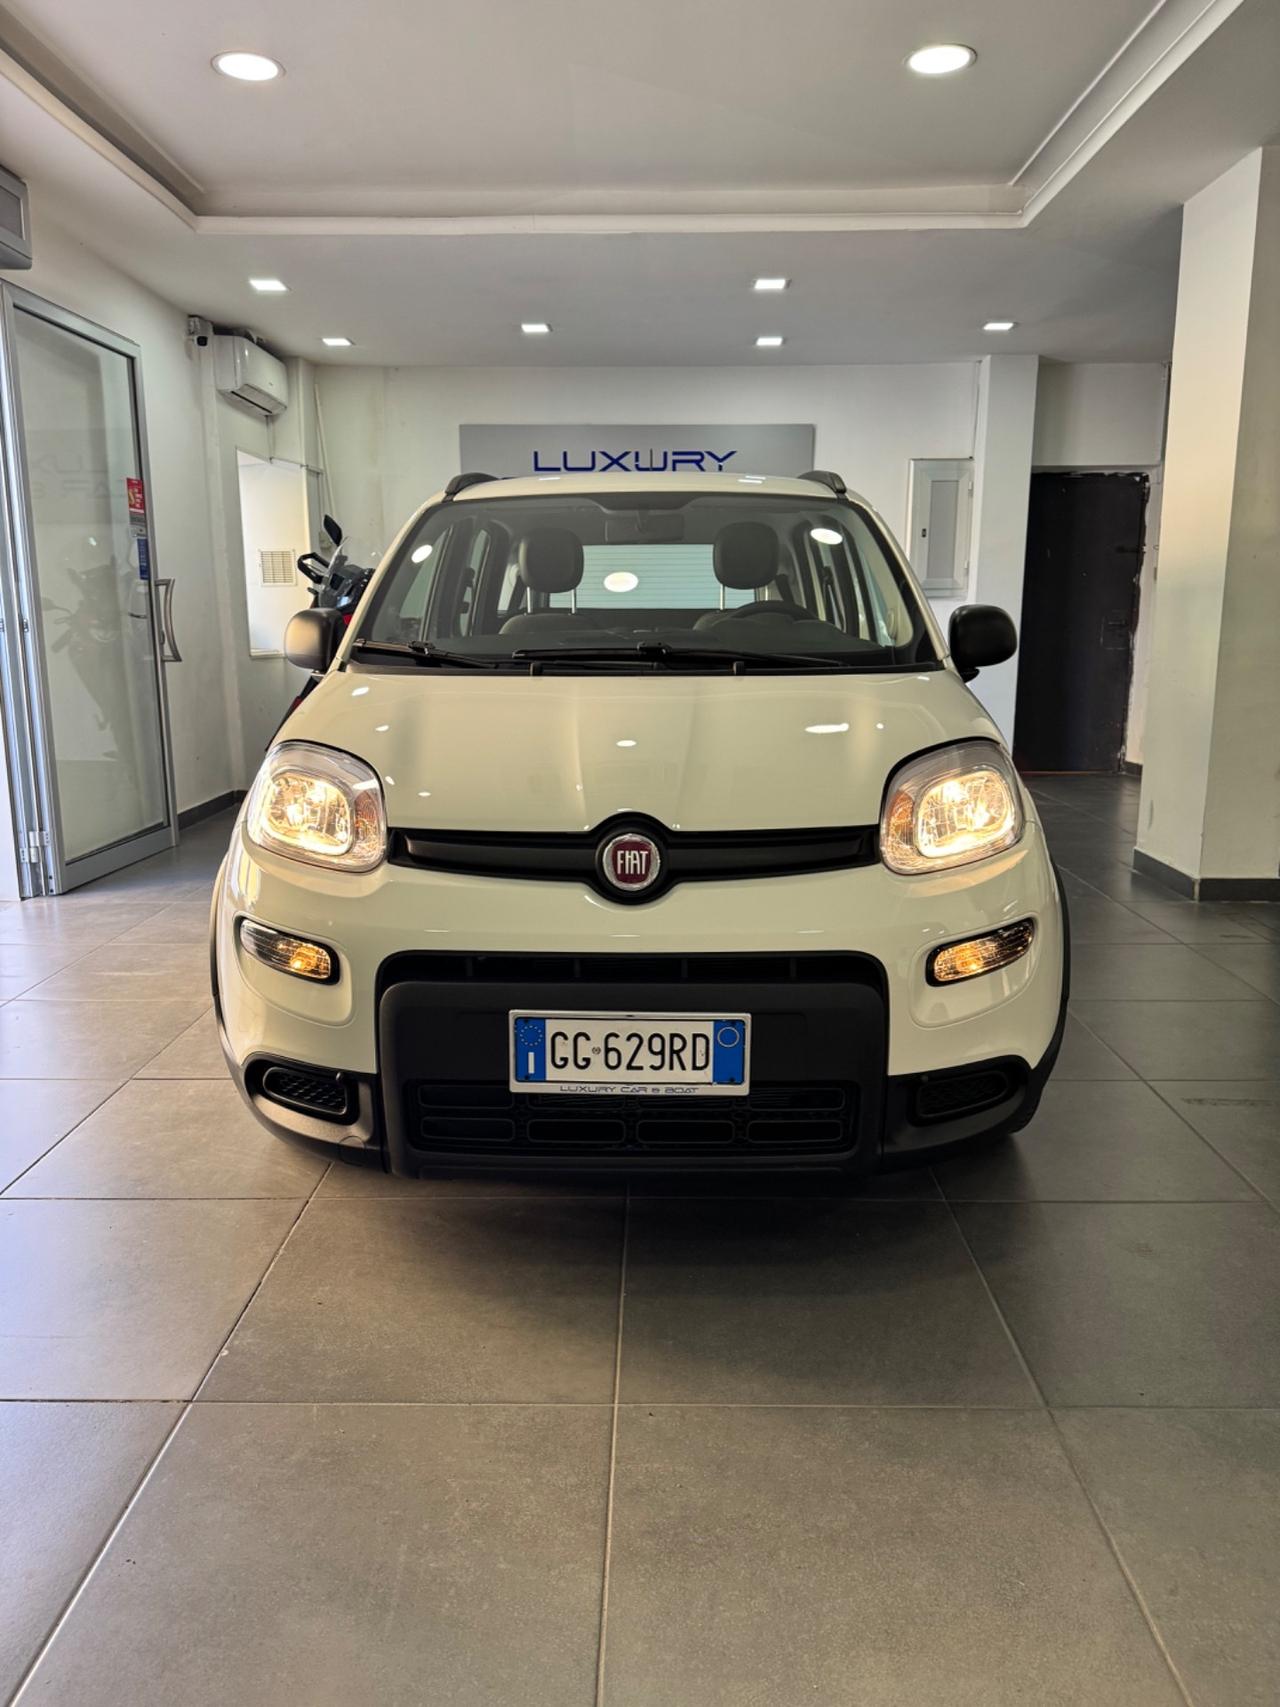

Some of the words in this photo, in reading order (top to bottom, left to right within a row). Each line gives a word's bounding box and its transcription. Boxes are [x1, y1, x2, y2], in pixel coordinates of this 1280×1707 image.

[533, 450, 738, 472] LUXURY
[616, 850, 649, 875] FIAT
[559, 1085, 617, 1093] LUXURY
[620, 1086, 648, 1094] CAR
[664, 1086, 700, 1095] BOAT
